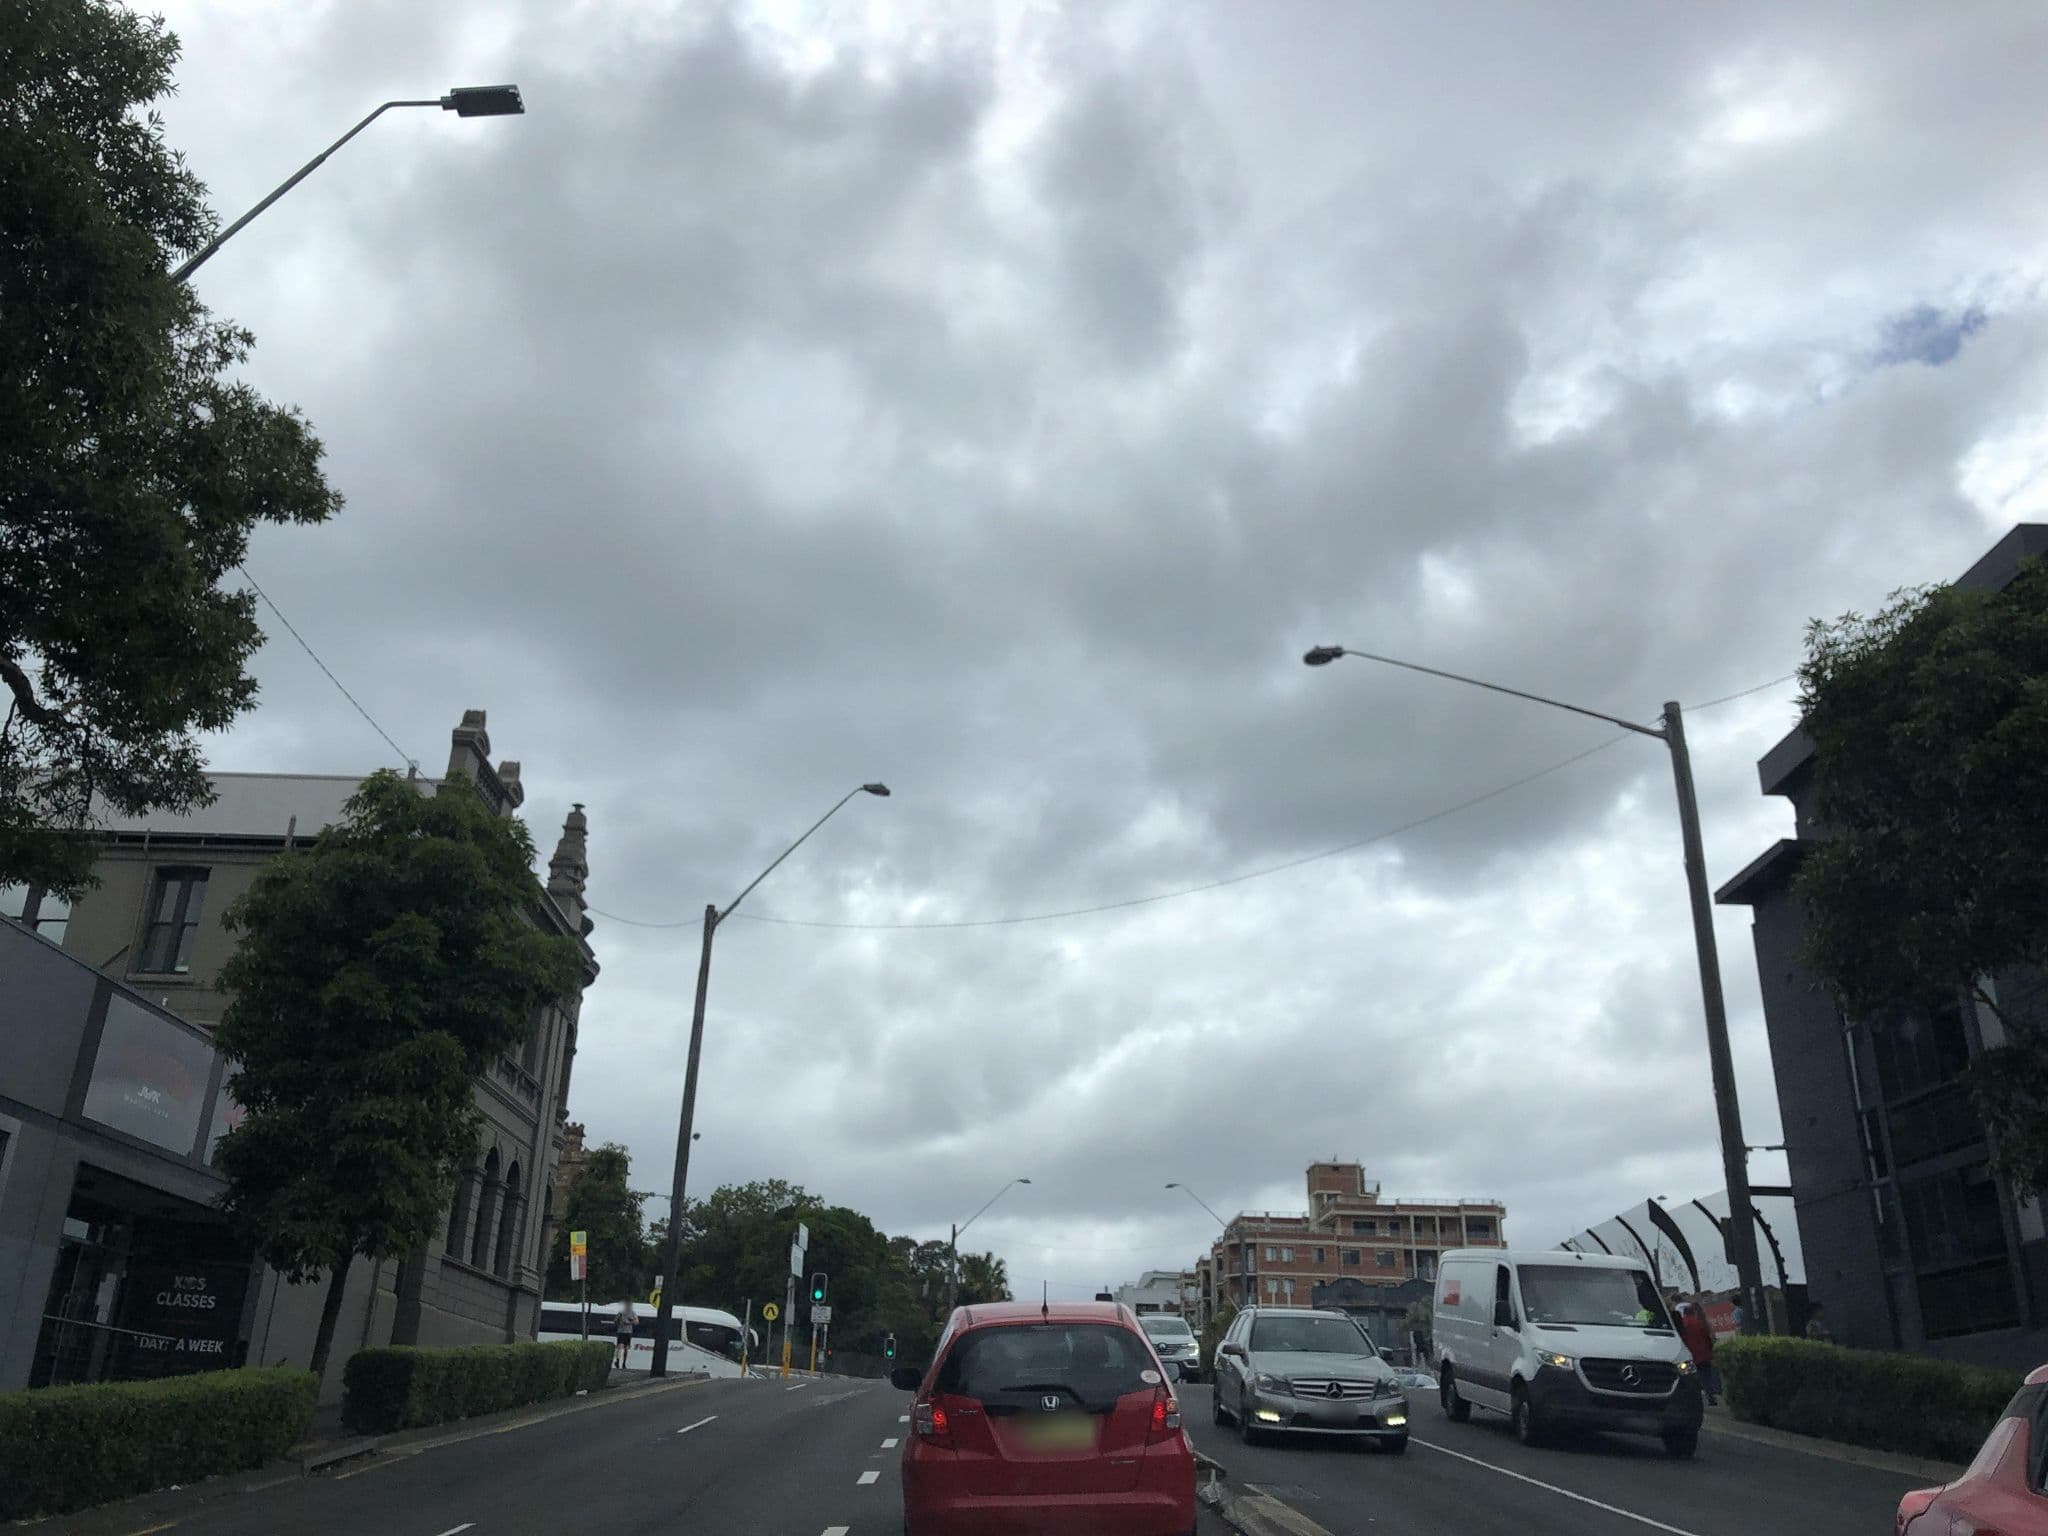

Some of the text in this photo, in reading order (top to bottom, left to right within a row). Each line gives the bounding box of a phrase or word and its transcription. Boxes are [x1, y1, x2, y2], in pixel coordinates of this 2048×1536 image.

[156, 1292, 216, 1309] CLASSES
[175, 1338, 185, 1351] A
[189, 1339, 224, 1353] WEEK
